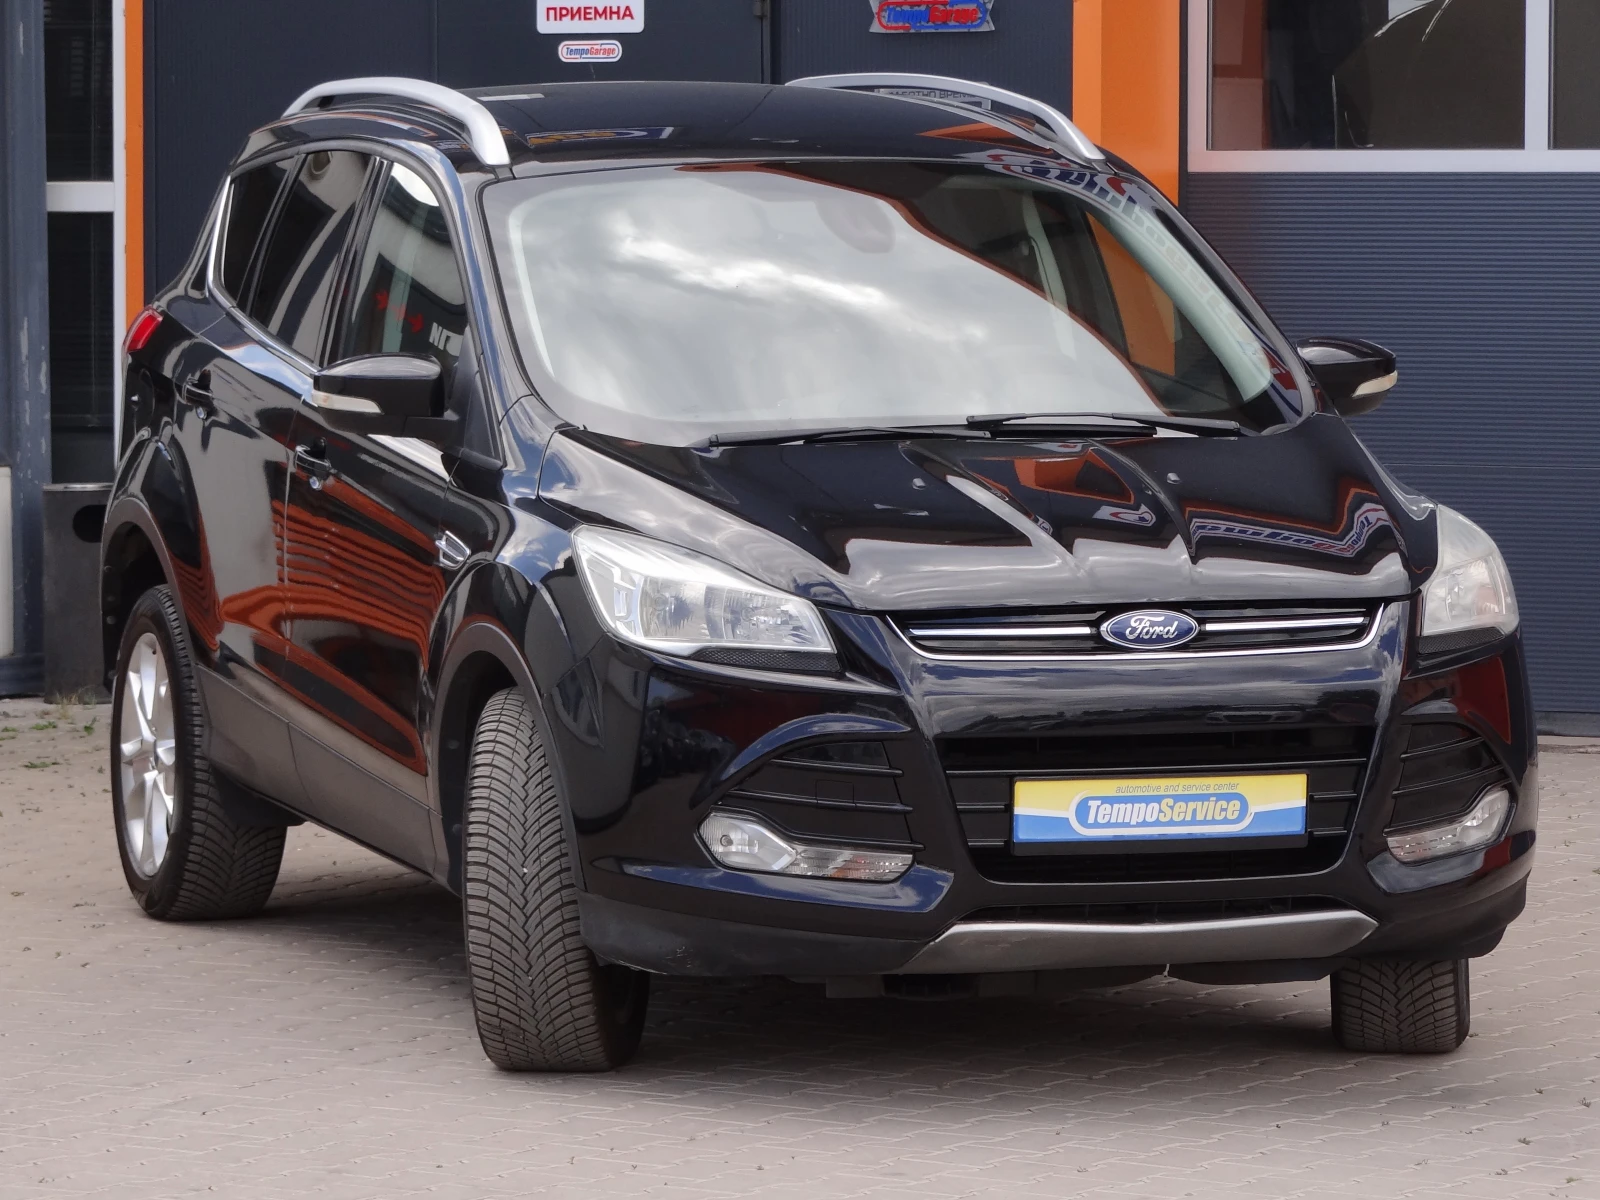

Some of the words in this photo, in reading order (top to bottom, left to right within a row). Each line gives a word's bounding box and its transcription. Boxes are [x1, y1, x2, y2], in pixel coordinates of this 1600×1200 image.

[546, 5, 635, 21] ПРИЕМНА
[565, 47, 616, 58] TempoGarage
[1125, 615, 1178, 640] Ford
[1116, 783, 1161, 794] automotive
[1164, 783, 1180, 793] and
[1182, 782, 1211, 792] service
[1213, 782, 1240, 791] center
[1087, 797, 1240, 825] TempoService
